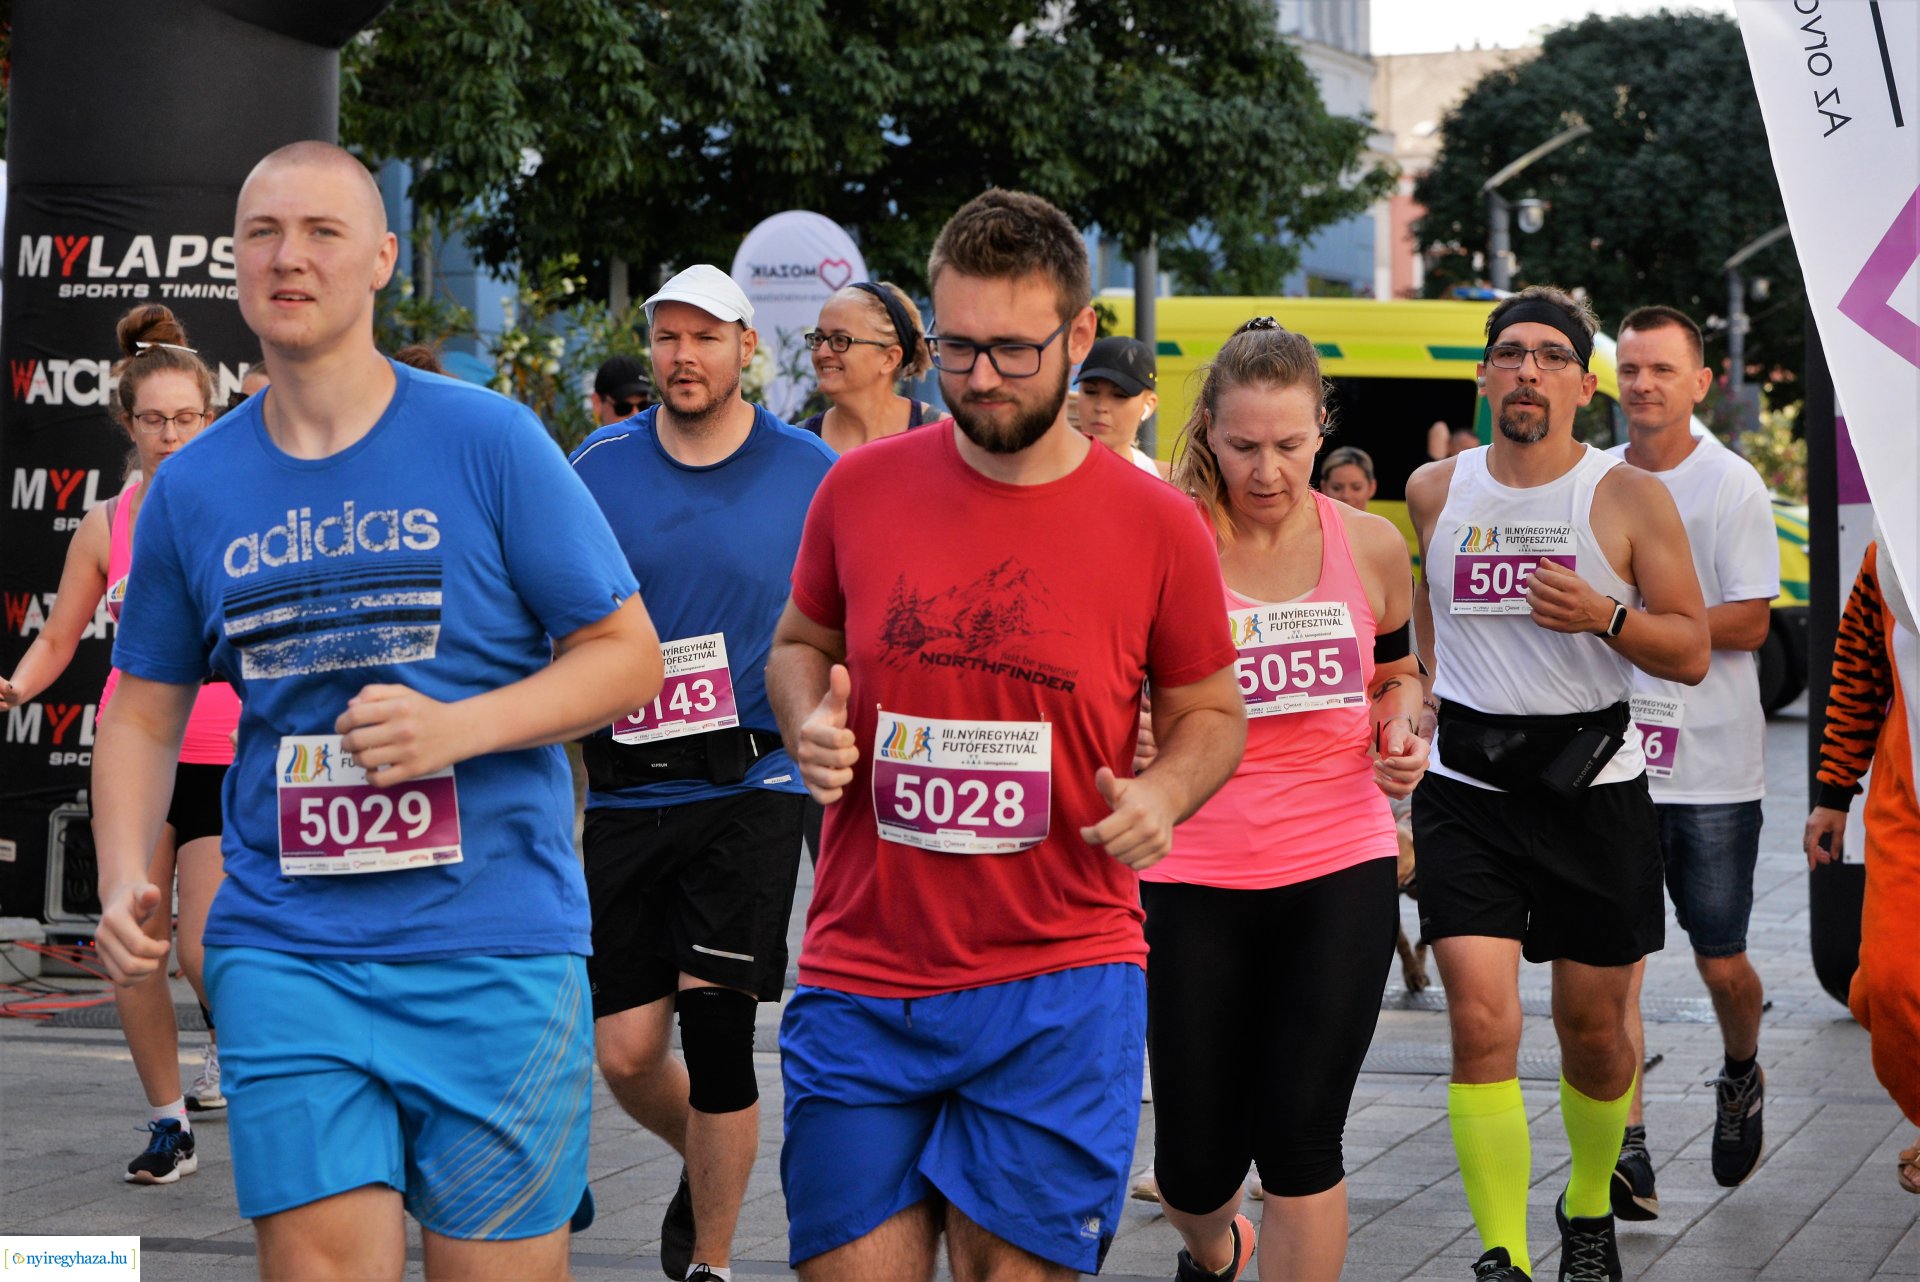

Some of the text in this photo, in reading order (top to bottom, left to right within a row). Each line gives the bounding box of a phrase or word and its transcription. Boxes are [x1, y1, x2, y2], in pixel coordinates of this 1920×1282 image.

[18, 235, 237, 279] MYLAPS
[58, 284, 239, 300] SPORTS TIMING
[223, 501, 441, 578] adidas
[1506, 535, 1569, 544] FUTÓFESZTIVÁL
[1469, 562, 1537, 595] 505
[1268, 607, 1341, 622] III.NYÍREGYHÁZI
[1270, 618, 1344, 632] FUTÓFESZTIVÁL
[660, 640, 716, 657] NYÍREGYHÁZI
[918, 651, 1077, 695] NORTHFINDER
[1233, 647, 1344, 695] 5055
[942, 728, 1040, 742] III.NYÍREGYHÁZI
[942, 740, 1038, 755] FUTÓFESZTIVÁL
[894, 773, 1025, 828] 5028
[299, 790, 433, 847] 5029
